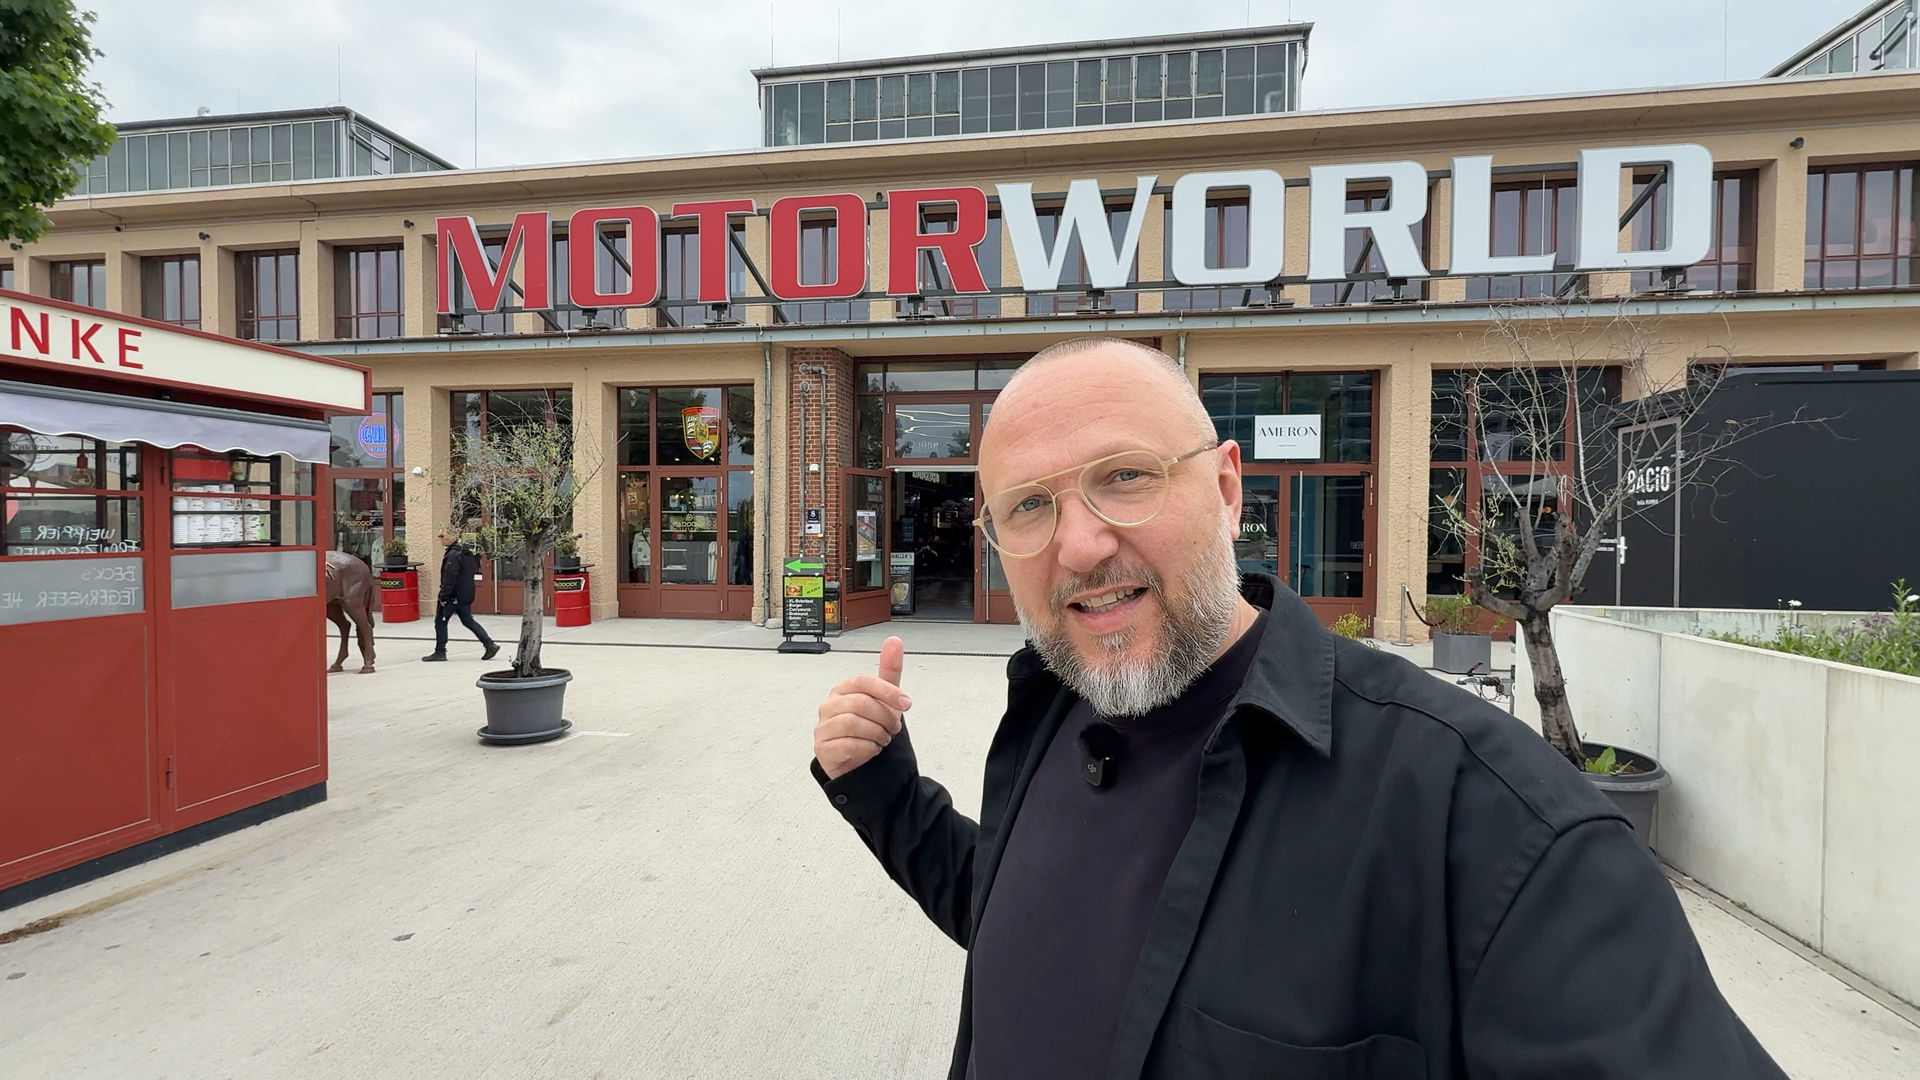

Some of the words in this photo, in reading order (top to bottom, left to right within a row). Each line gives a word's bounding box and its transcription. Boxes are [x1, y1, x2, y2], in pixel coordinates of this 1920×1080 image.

[436, 143, 1714, 315] MOTORWORLD
[10, 306, 144, 370] NKE
[361, 425, 387, 444] GUL
[1258, 426, 1318, 437] AMERON
[810, 510, 816, 518] 8
